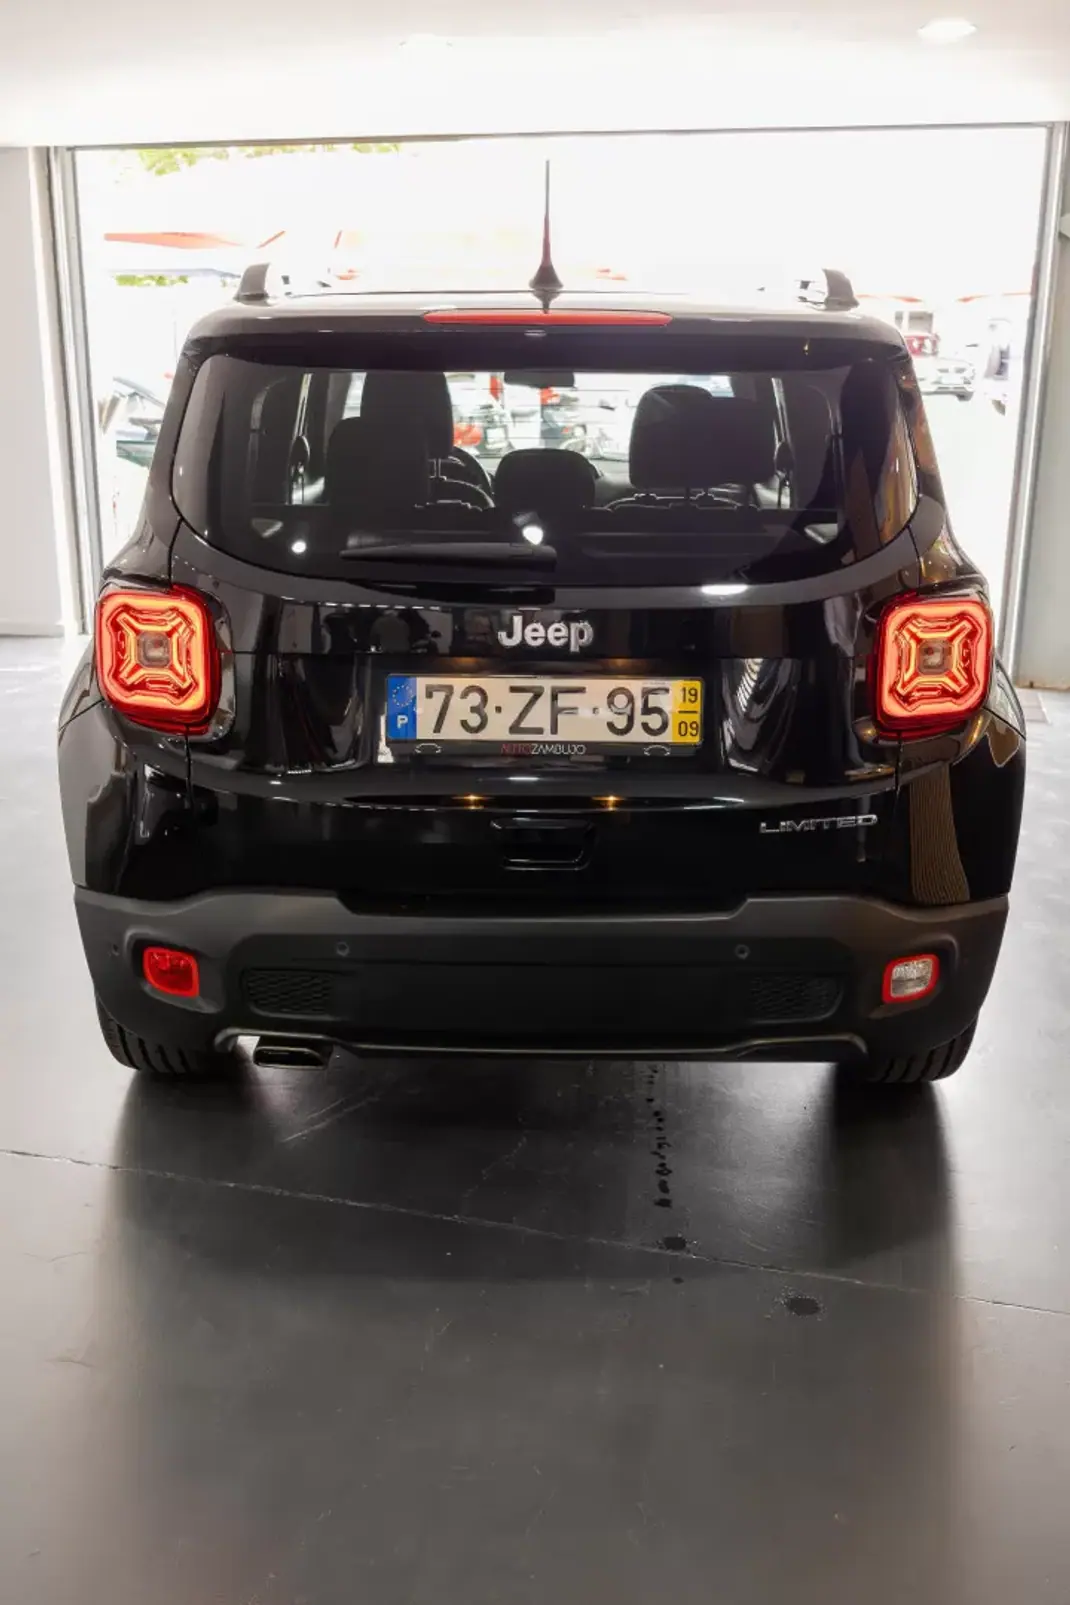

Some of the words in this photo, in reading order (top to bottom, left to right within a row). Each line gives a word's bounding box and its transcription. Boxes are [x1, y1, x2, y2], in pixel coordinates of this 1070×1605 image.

[498, 614, 594, 652] Jeep
[682, 687, 698, 704] 19
[397, 714, 409, 729] P
[678, 720, 699, 737] 09
[760, 814, 878, 833] LIMITED
